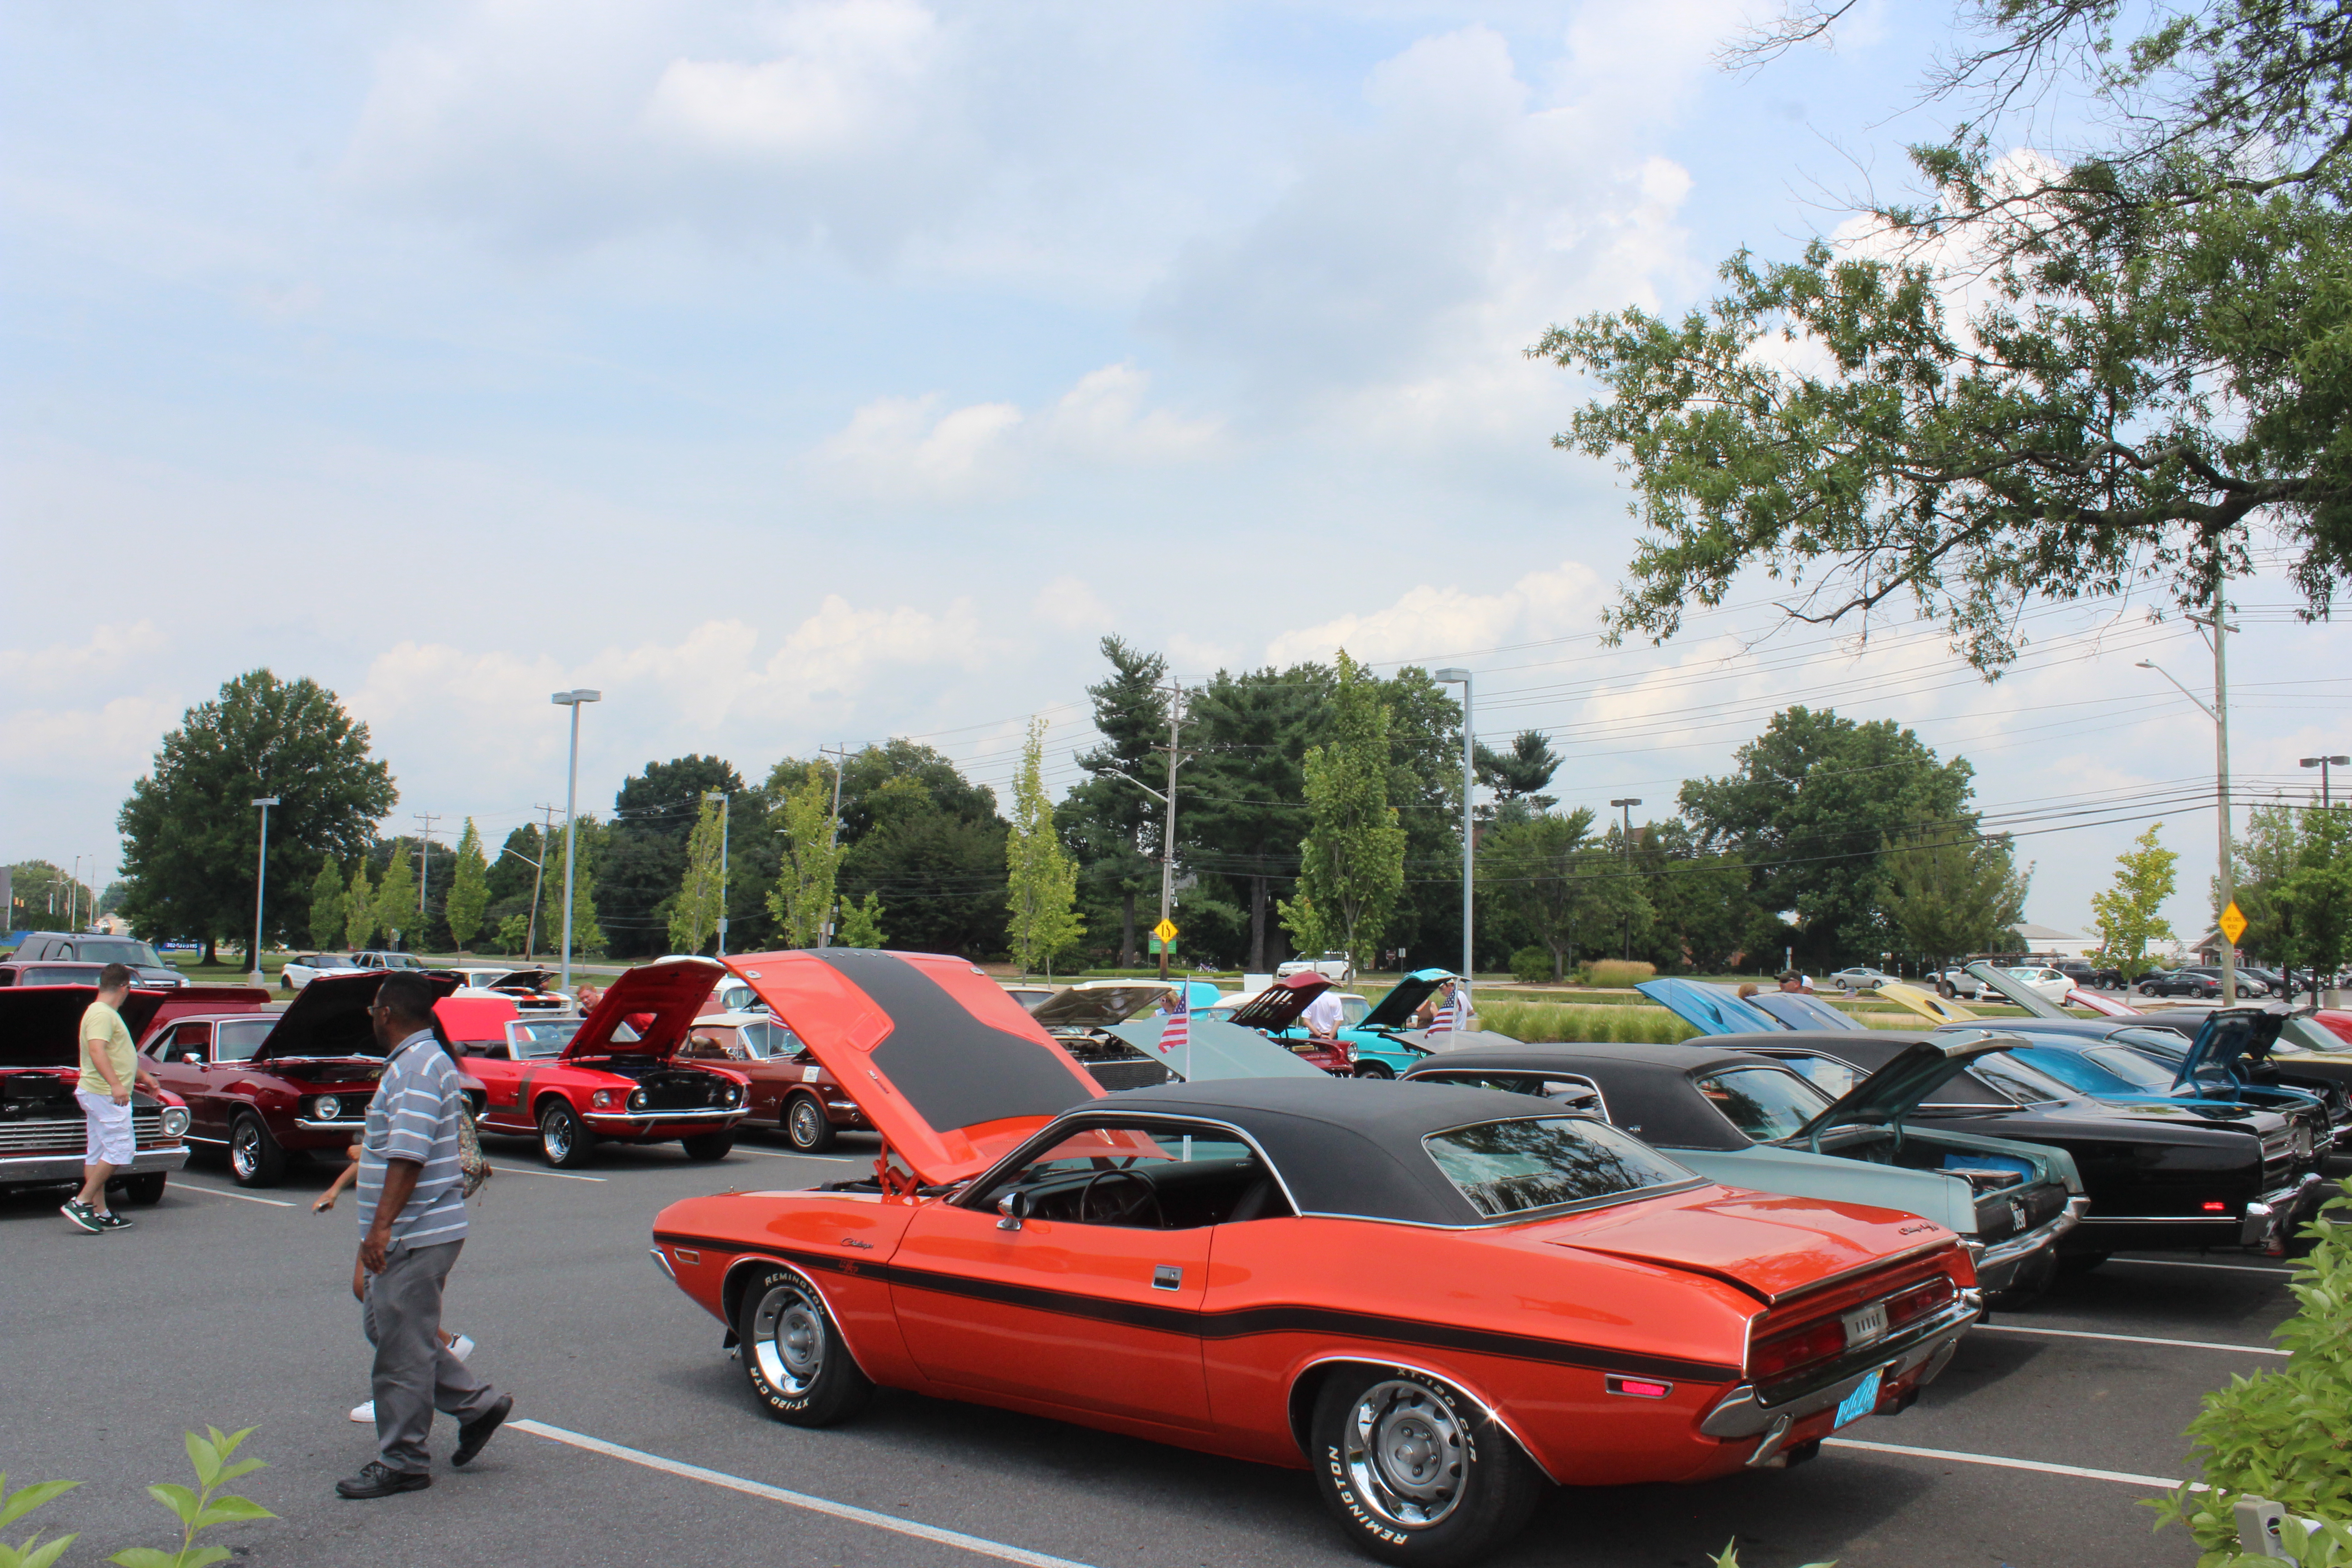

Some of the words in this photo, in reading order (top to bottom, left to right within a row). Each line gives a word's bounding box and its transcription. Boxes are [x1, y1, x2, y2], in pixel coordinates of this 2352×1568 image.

[764, 1272, 825, 1315] REMINGTON
[750, 1366, 769, 1395] CTR
[770, 1396, 809, 1410] XT-120
[1396, 1367, 1456, 1407] XT-120
[1459, 1417, 1477, 1462] CTR
[1328, 1445, 1408, 1545] REMINGTON
